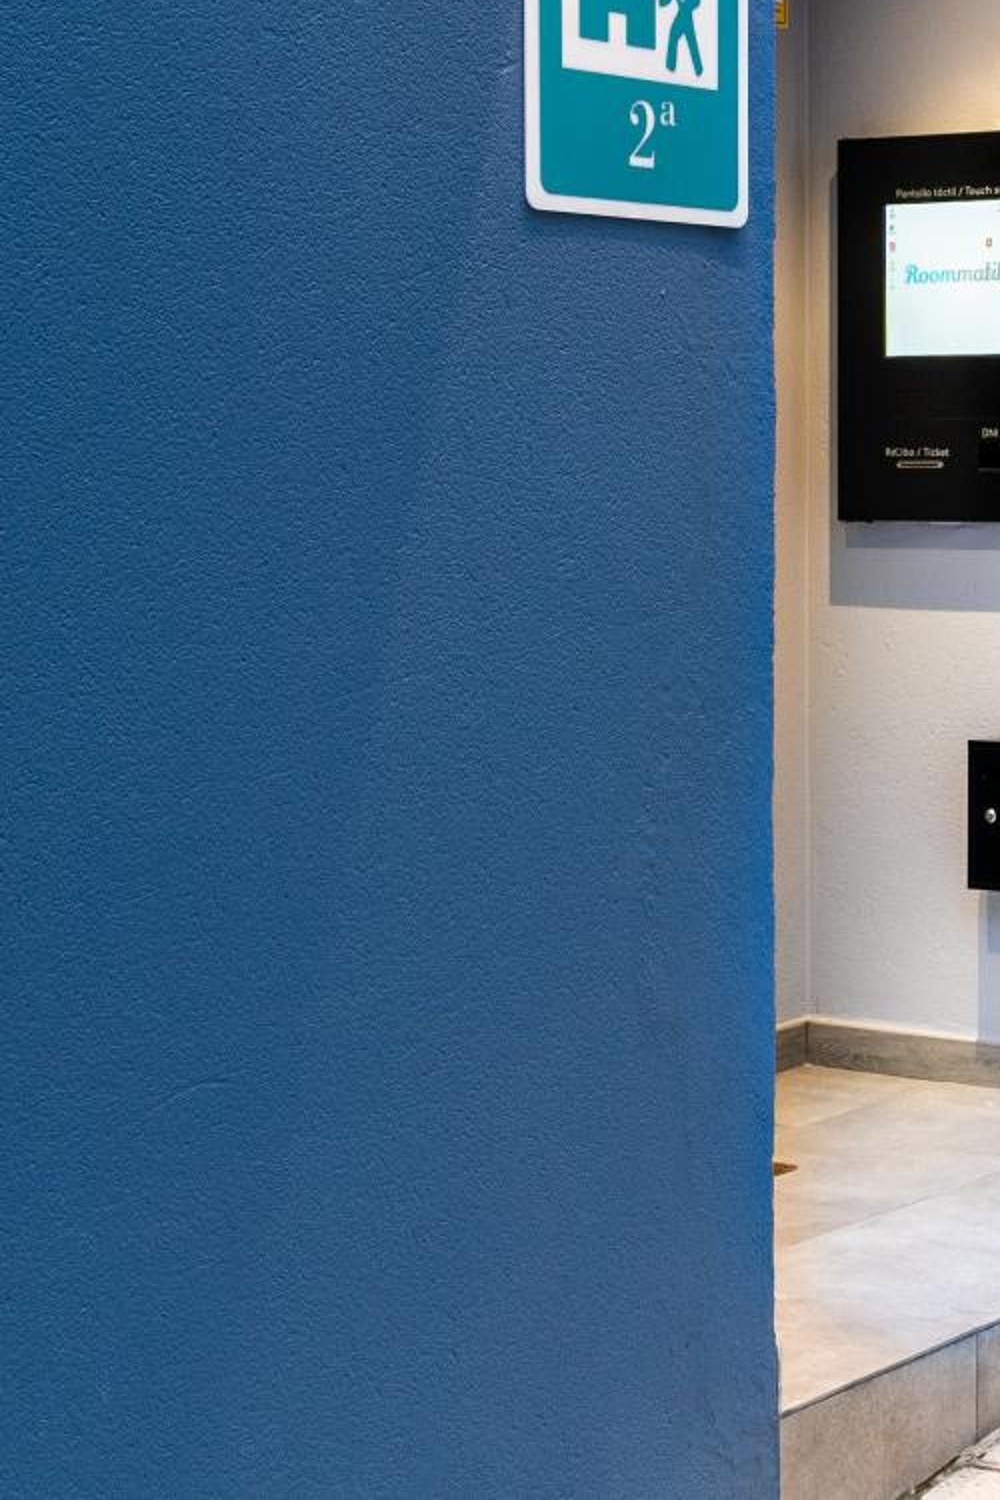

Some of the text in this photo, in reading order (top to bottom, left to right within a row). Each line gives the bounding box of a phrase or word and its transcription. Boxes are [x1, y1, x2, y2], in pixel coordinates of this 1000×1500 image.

[964, 185, 993, 197] Touch
[981, 427, 999, 438] DNI
[922, 446, 950, 457] Ticket
